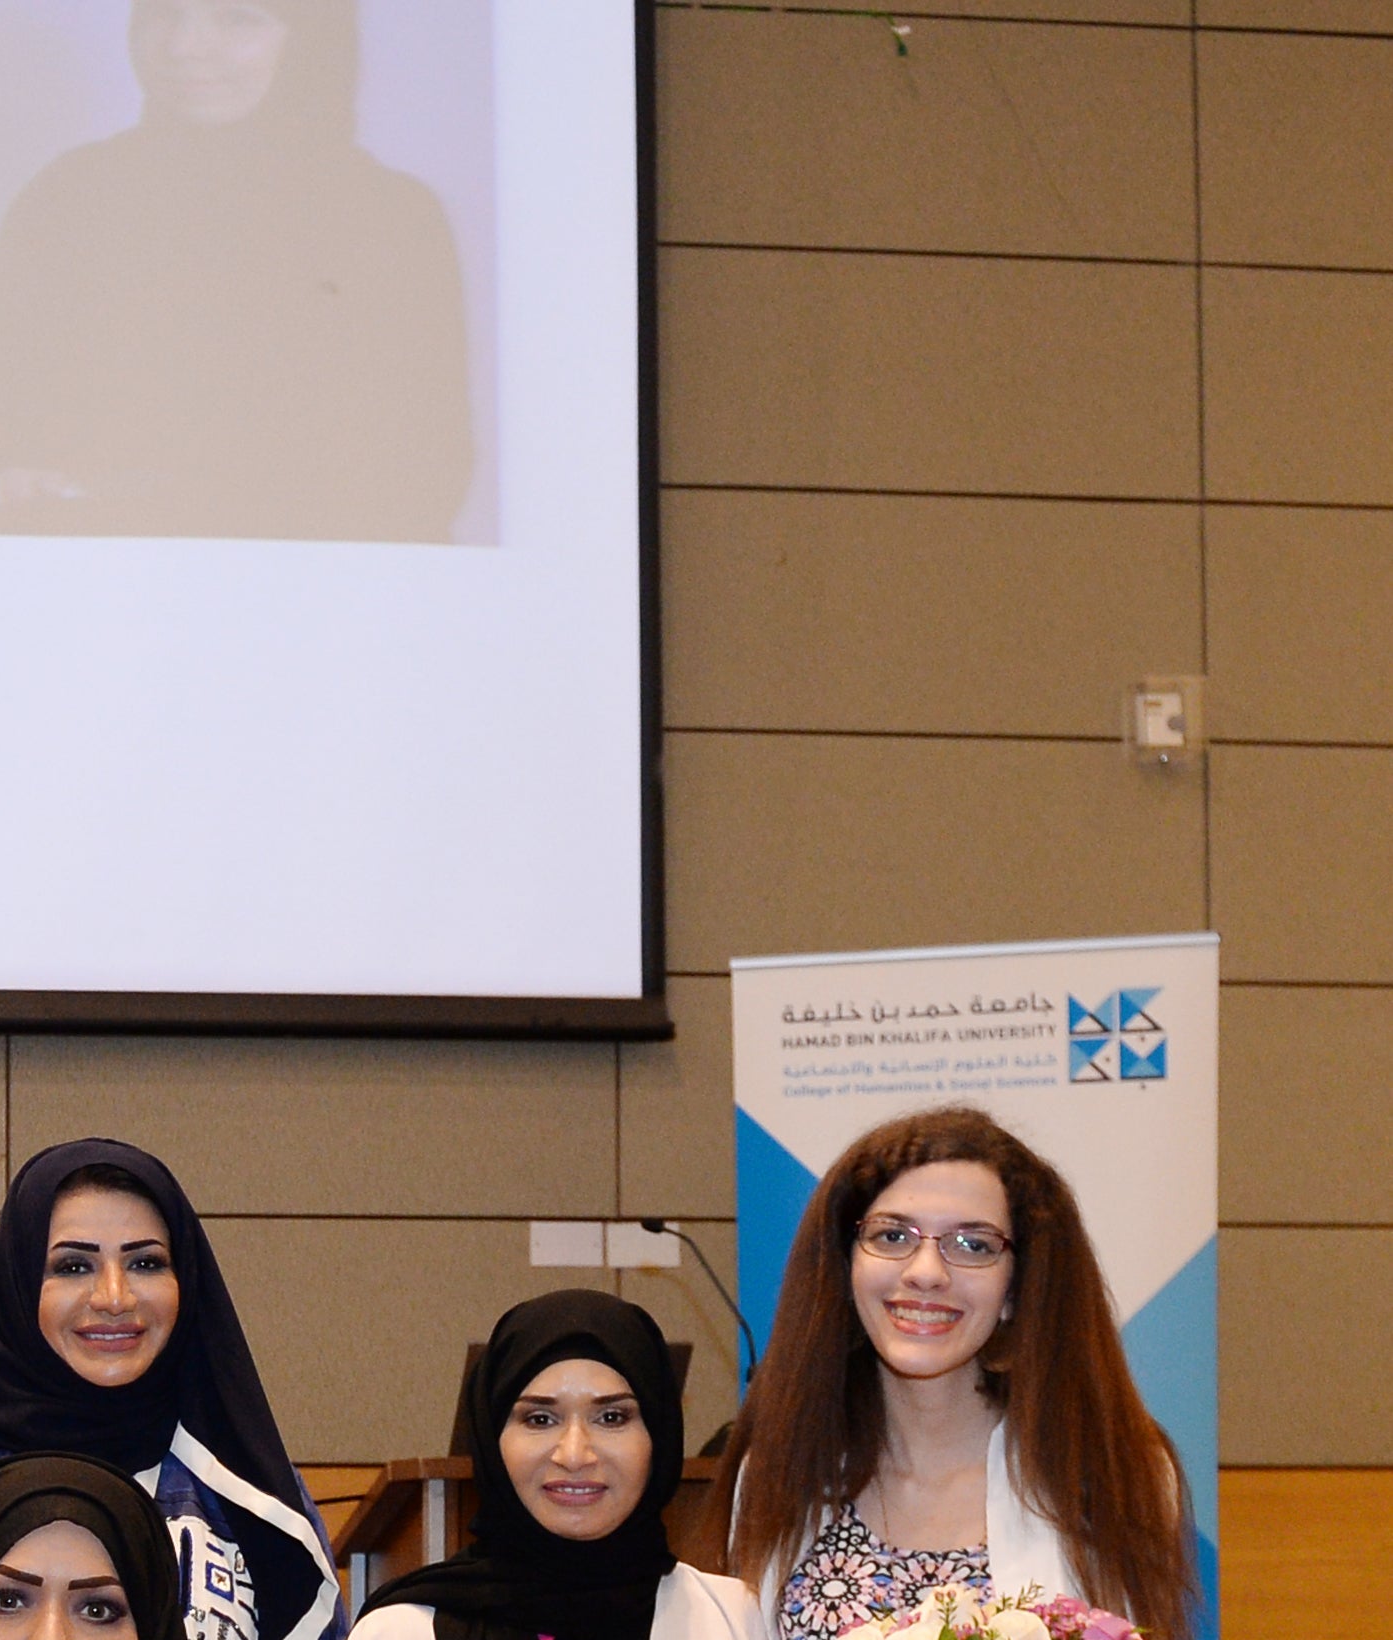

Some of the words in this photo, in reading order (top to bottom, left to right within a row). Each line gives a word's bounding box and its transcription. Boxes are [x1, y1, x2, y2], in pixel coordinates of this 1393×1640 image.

[907, 1003, 961, 1019] حمد
[970, 991, 1054, 1018] جامعة
[781, 1033, 842, 1049] HAMAD
[846, 1032, 875, 1047] BIN
[880, 1029, 952, 1045] KHALIFA
[958, 1023, 1056, 1042] UNIVERSITY
